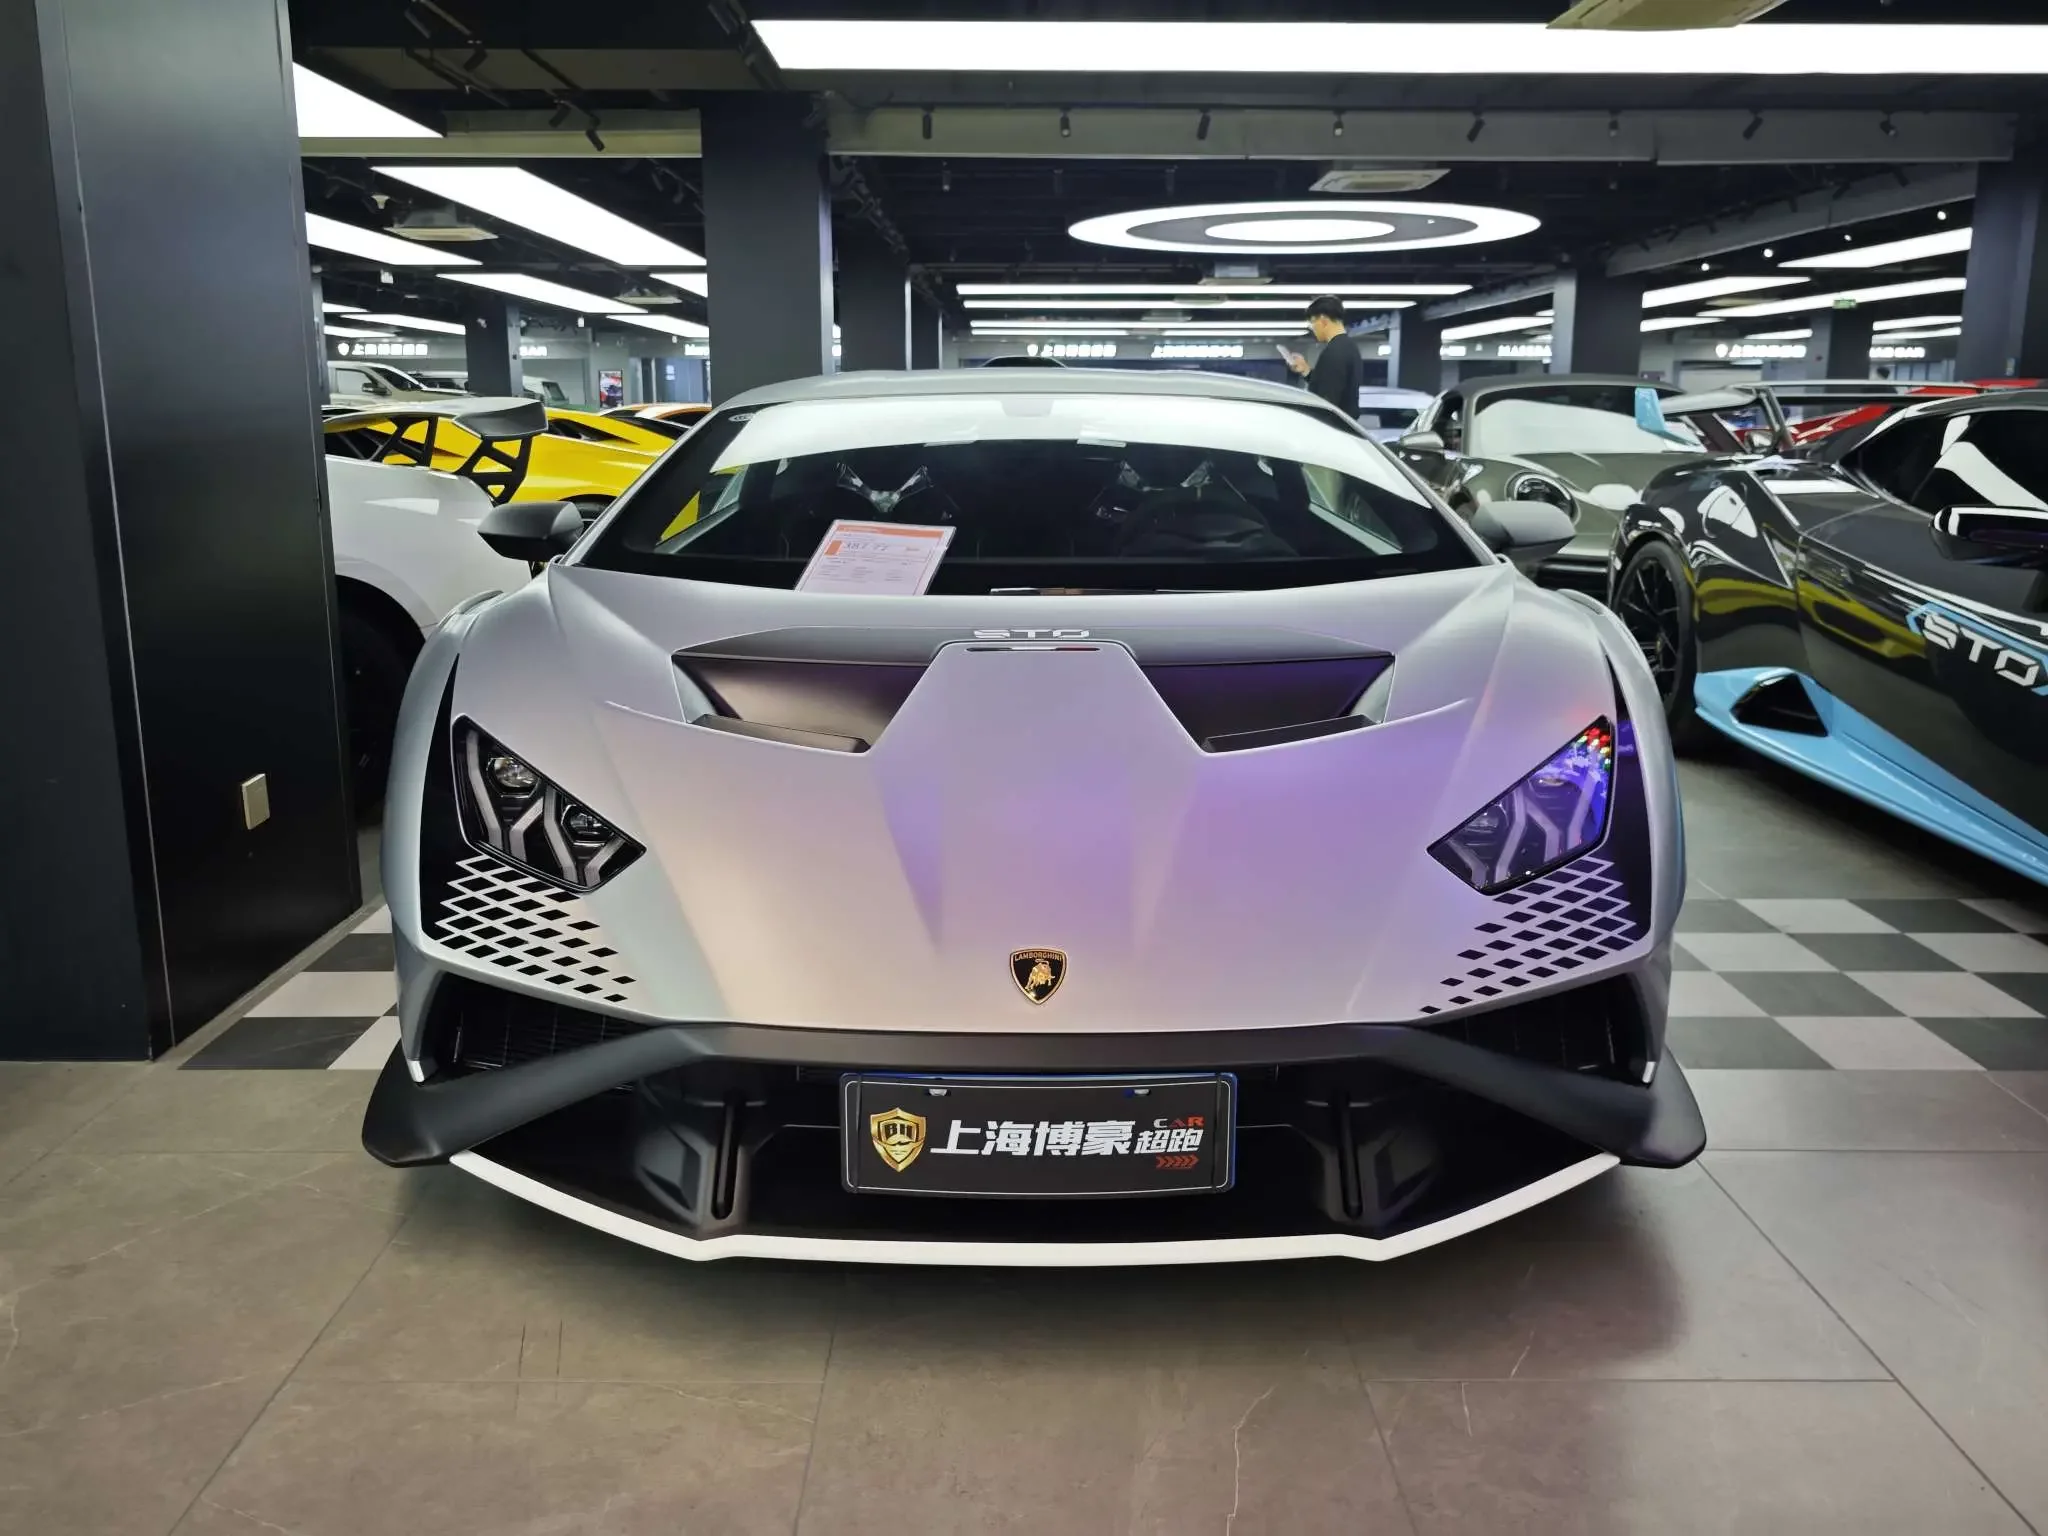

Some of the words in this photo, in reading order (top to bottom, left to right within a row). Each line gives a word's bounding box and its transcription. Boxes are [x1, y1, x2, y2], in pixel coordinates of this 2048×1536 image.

[973, 629, 1090, 639] STO
[1923, 612, 2041, 687] STO
[1014, 951, 1062, 961] LAMBORGHINI
[1153, 1116, 1204, 1128] CAR
